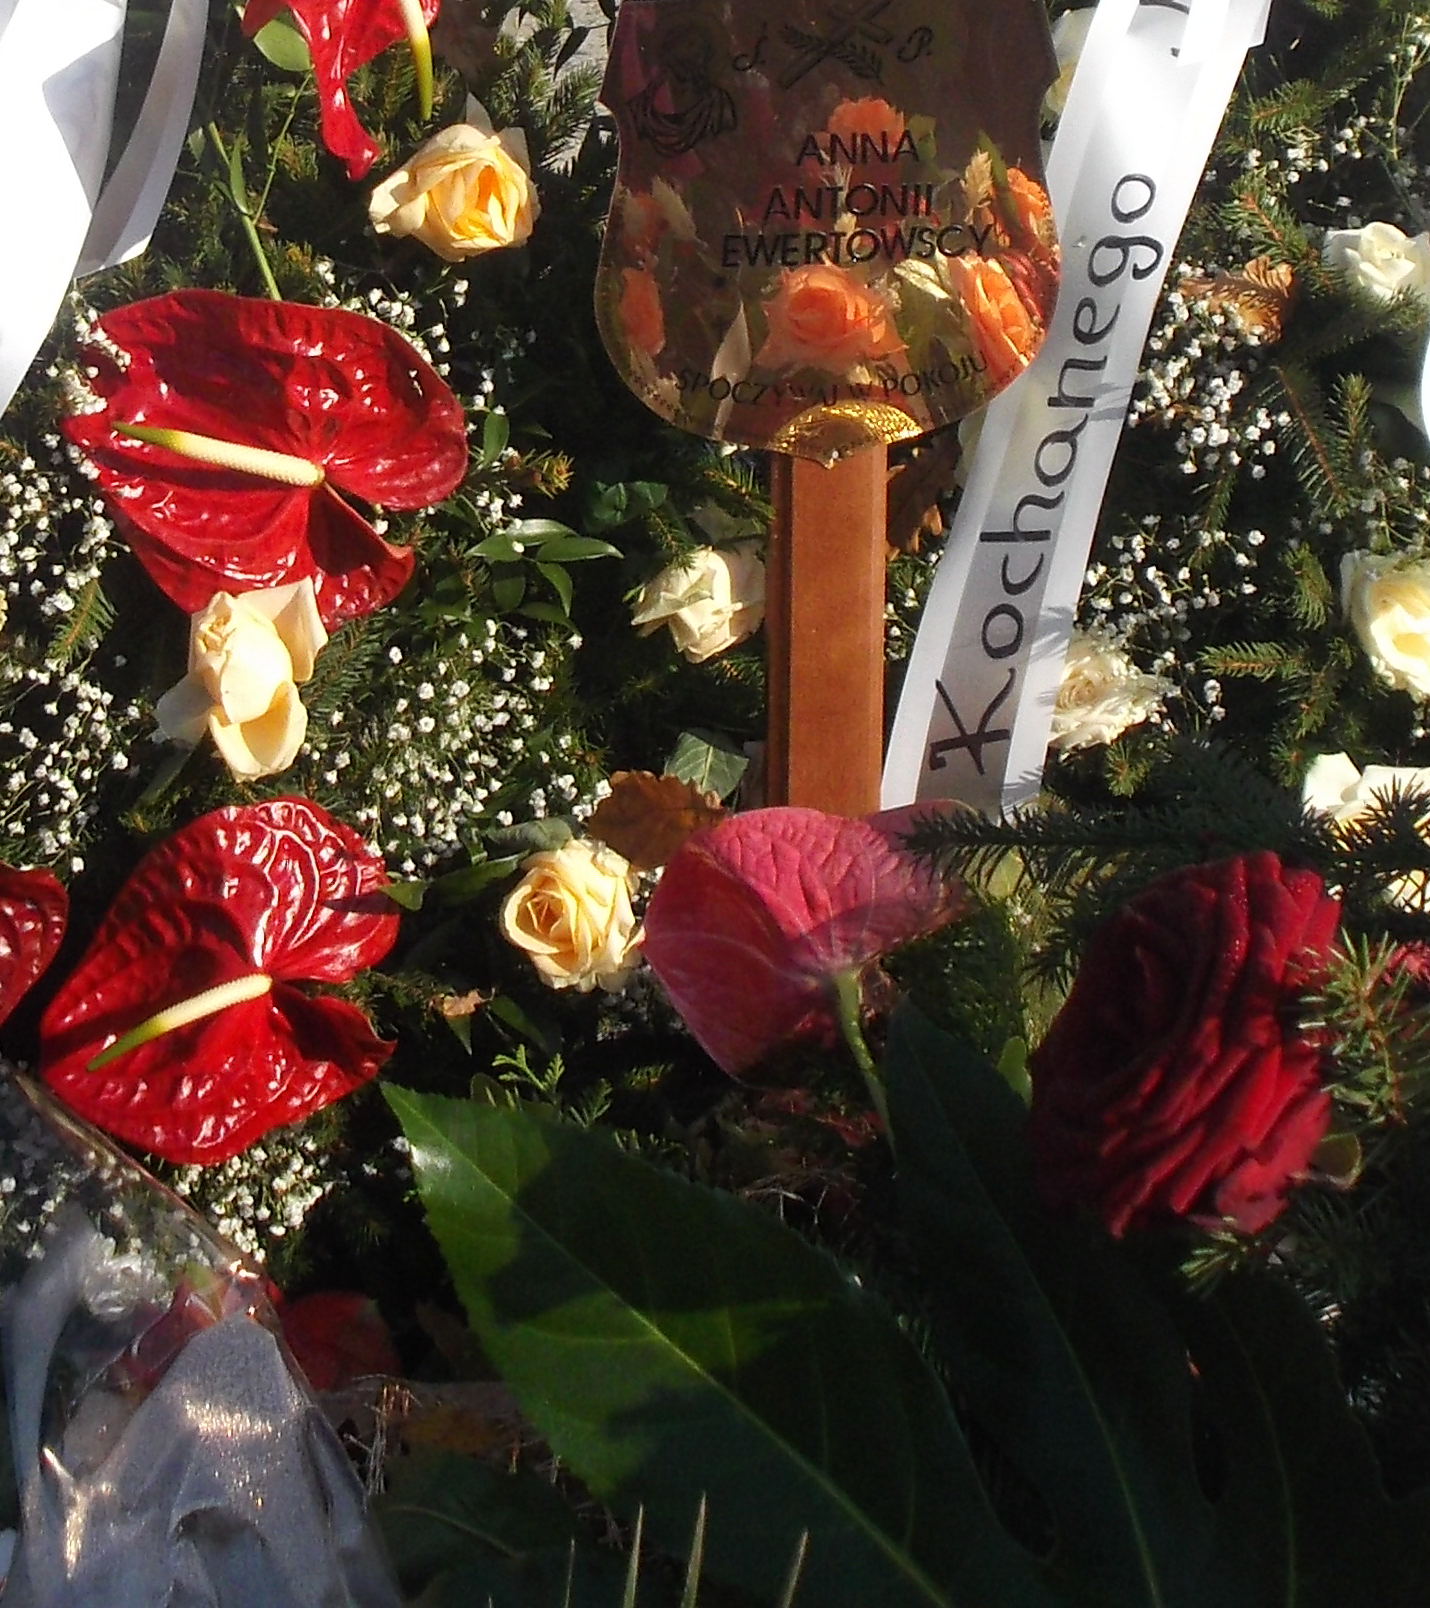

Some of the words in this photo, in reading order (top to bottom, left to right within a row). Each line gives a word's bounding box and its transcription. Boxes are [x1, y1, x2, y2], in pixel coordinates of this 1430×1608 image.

[796, 128, 920, 168] ANNA
[763, 181, 934, 225] ANTONII
[721, 223, 996, 270] EWERTOWSCY
[676, 368, 839, 406] SPOCZYWAJ
[847, 383, 873, 402] W
[884, 355, 989, 399] POKOJU
[928, 173, 1168, 777] Kochanego
